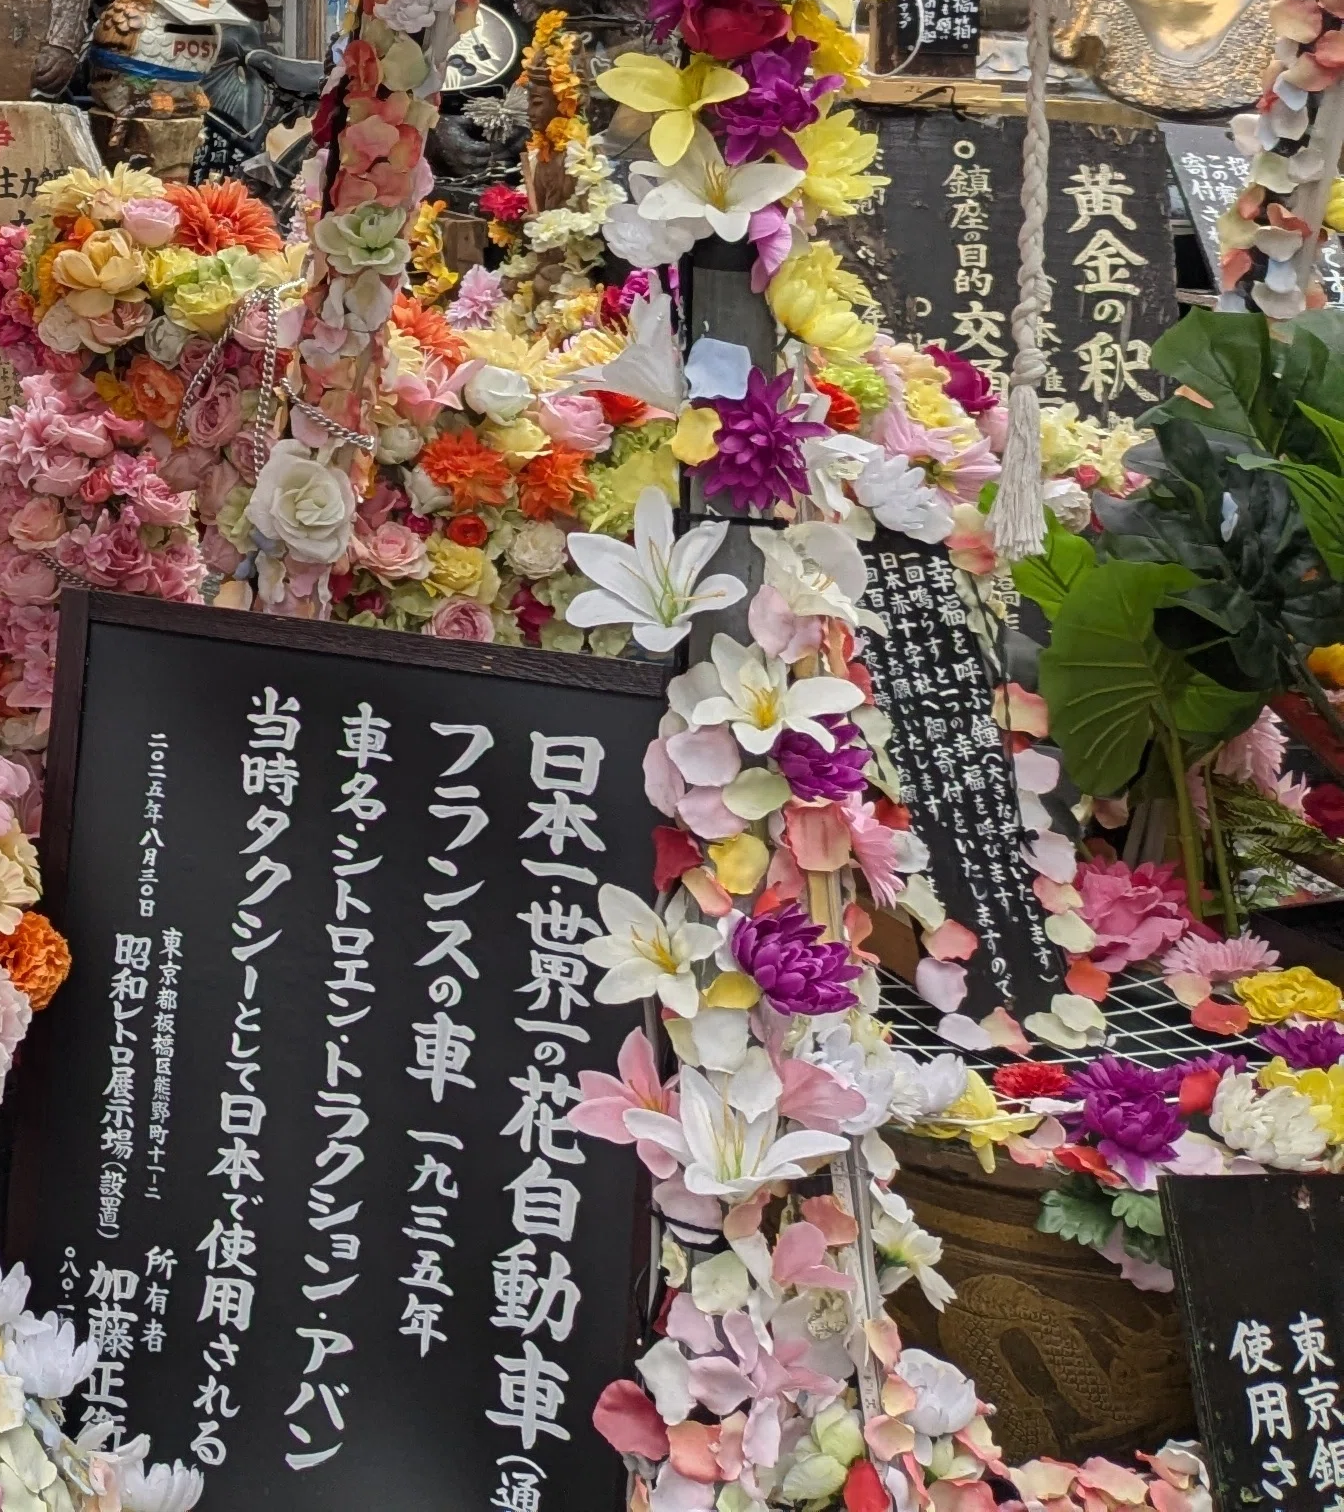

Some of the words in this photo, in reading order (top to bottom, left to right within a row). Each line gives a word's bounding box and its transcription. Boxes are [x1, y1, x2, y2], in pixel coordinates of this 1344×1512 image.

[172, 40, 218, 59] POST
[405, 721, 495, 1103] フランスの車
[139, 1245, 179, 1354] 所有者
[398, 1129, 464, 1358] 一九三五年
